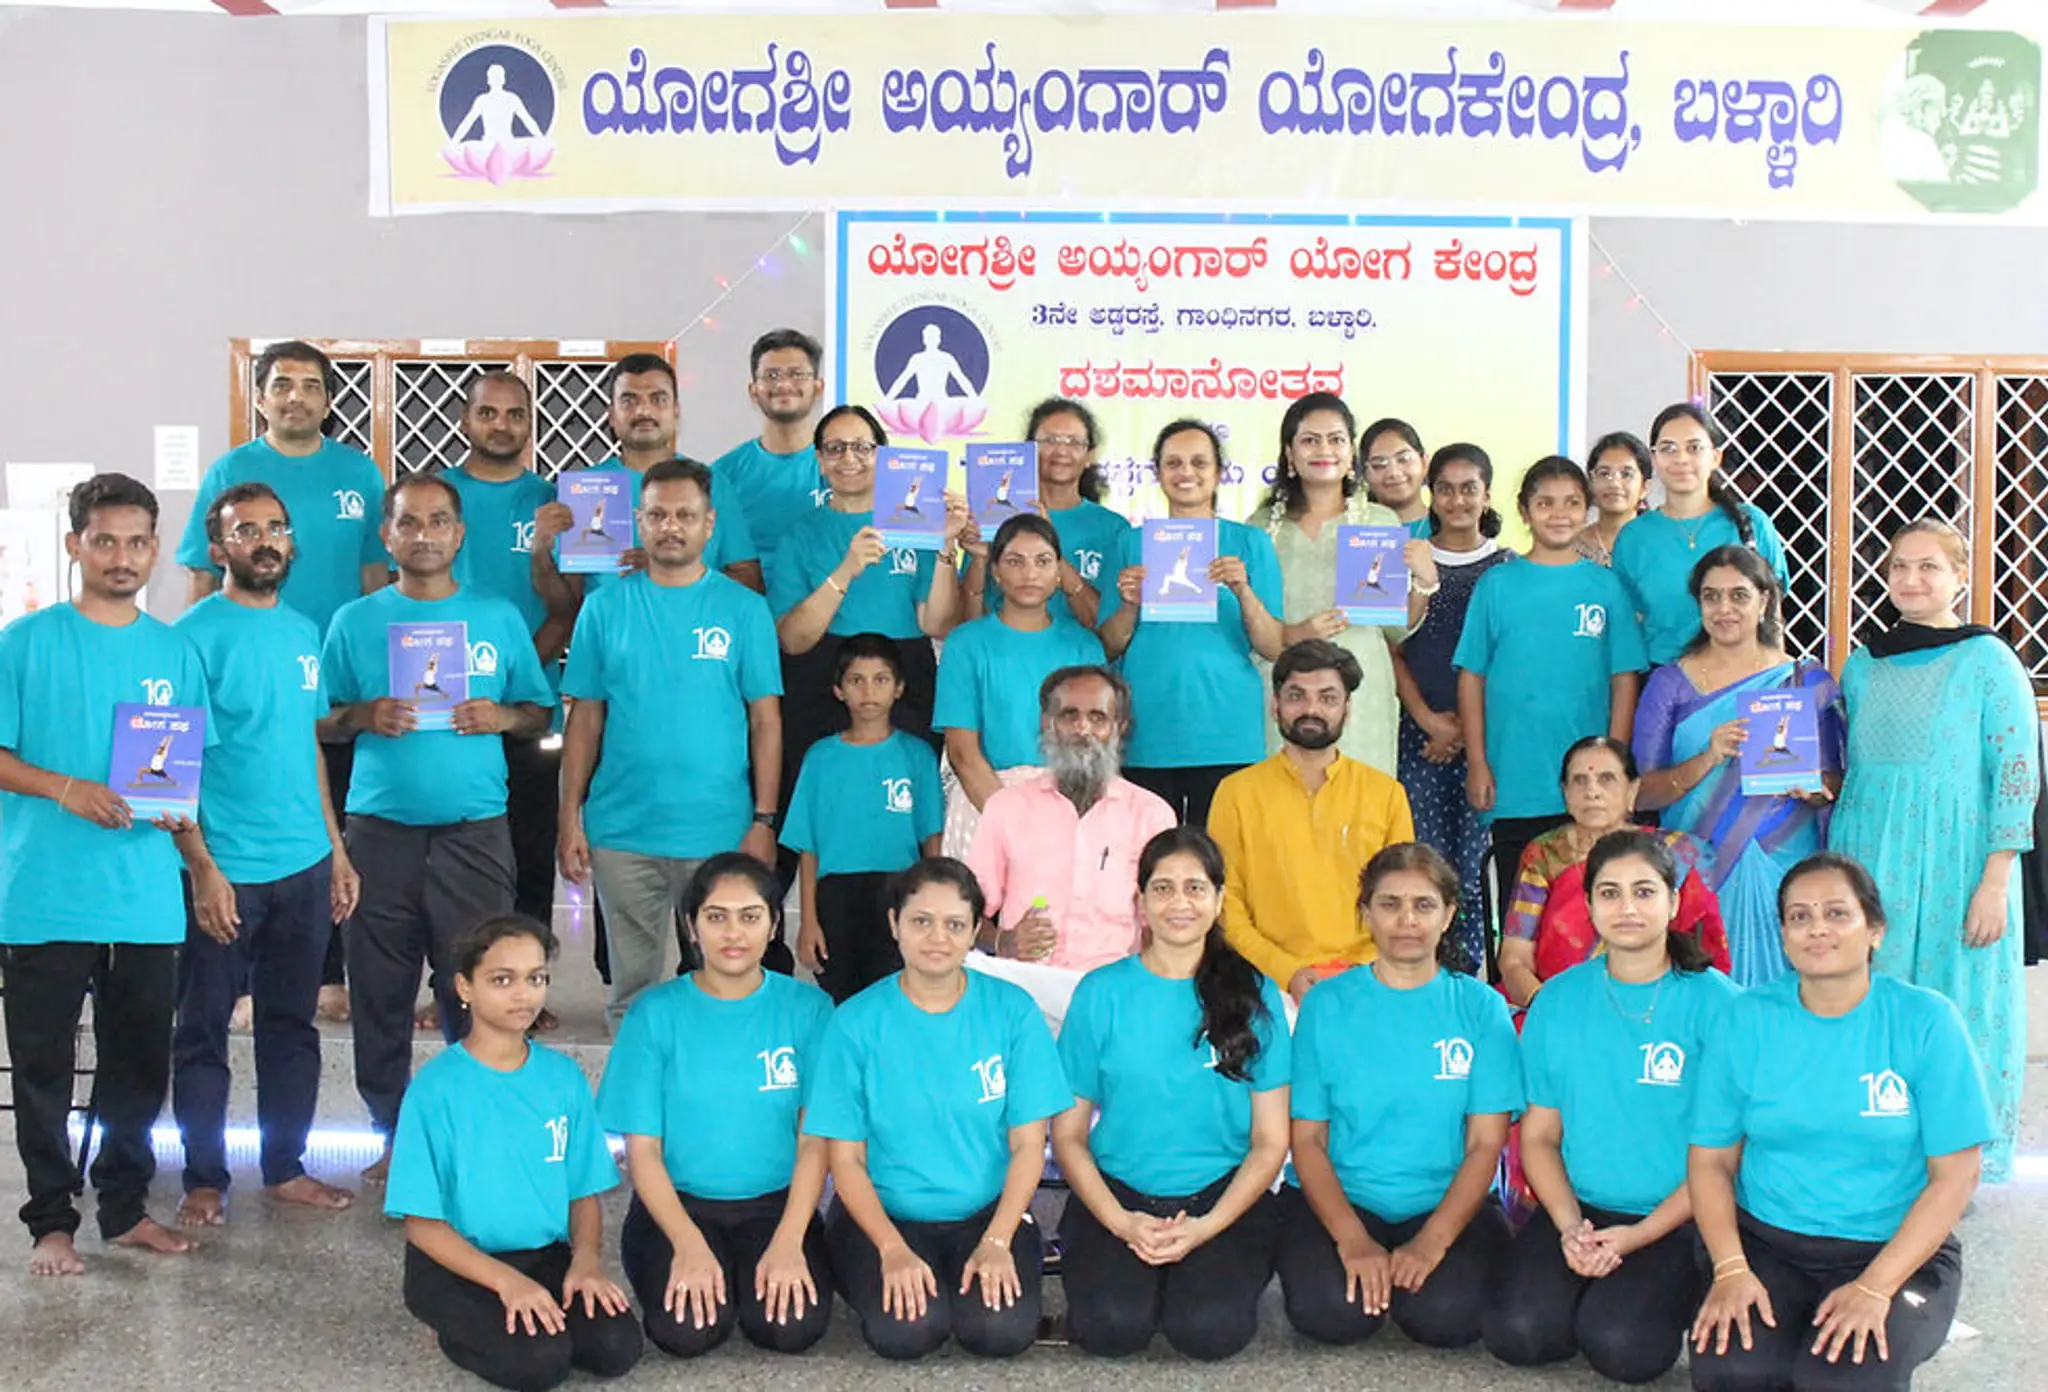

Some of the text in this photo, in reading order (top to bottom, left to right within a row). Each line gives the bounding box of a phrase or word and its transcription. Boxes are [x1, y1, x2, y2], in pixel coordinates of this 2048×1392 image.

[583, 43, 1844, 189] ಯೋಗಶ್ರೀ ಅಯ್ಯಂಗಾರ್ ಯೋಗಕೇಂದ್ರ, ಬಳ್ಳಾರಿ
[867, 233, 1538, 295] ಯೋಗಶ್ರೀ ಅಯ್ಯಂಗಾರ್ ಯೋಗ ಕೇಂದ್ರ
[1032, 302, 1078, 326] 3ನೇ
